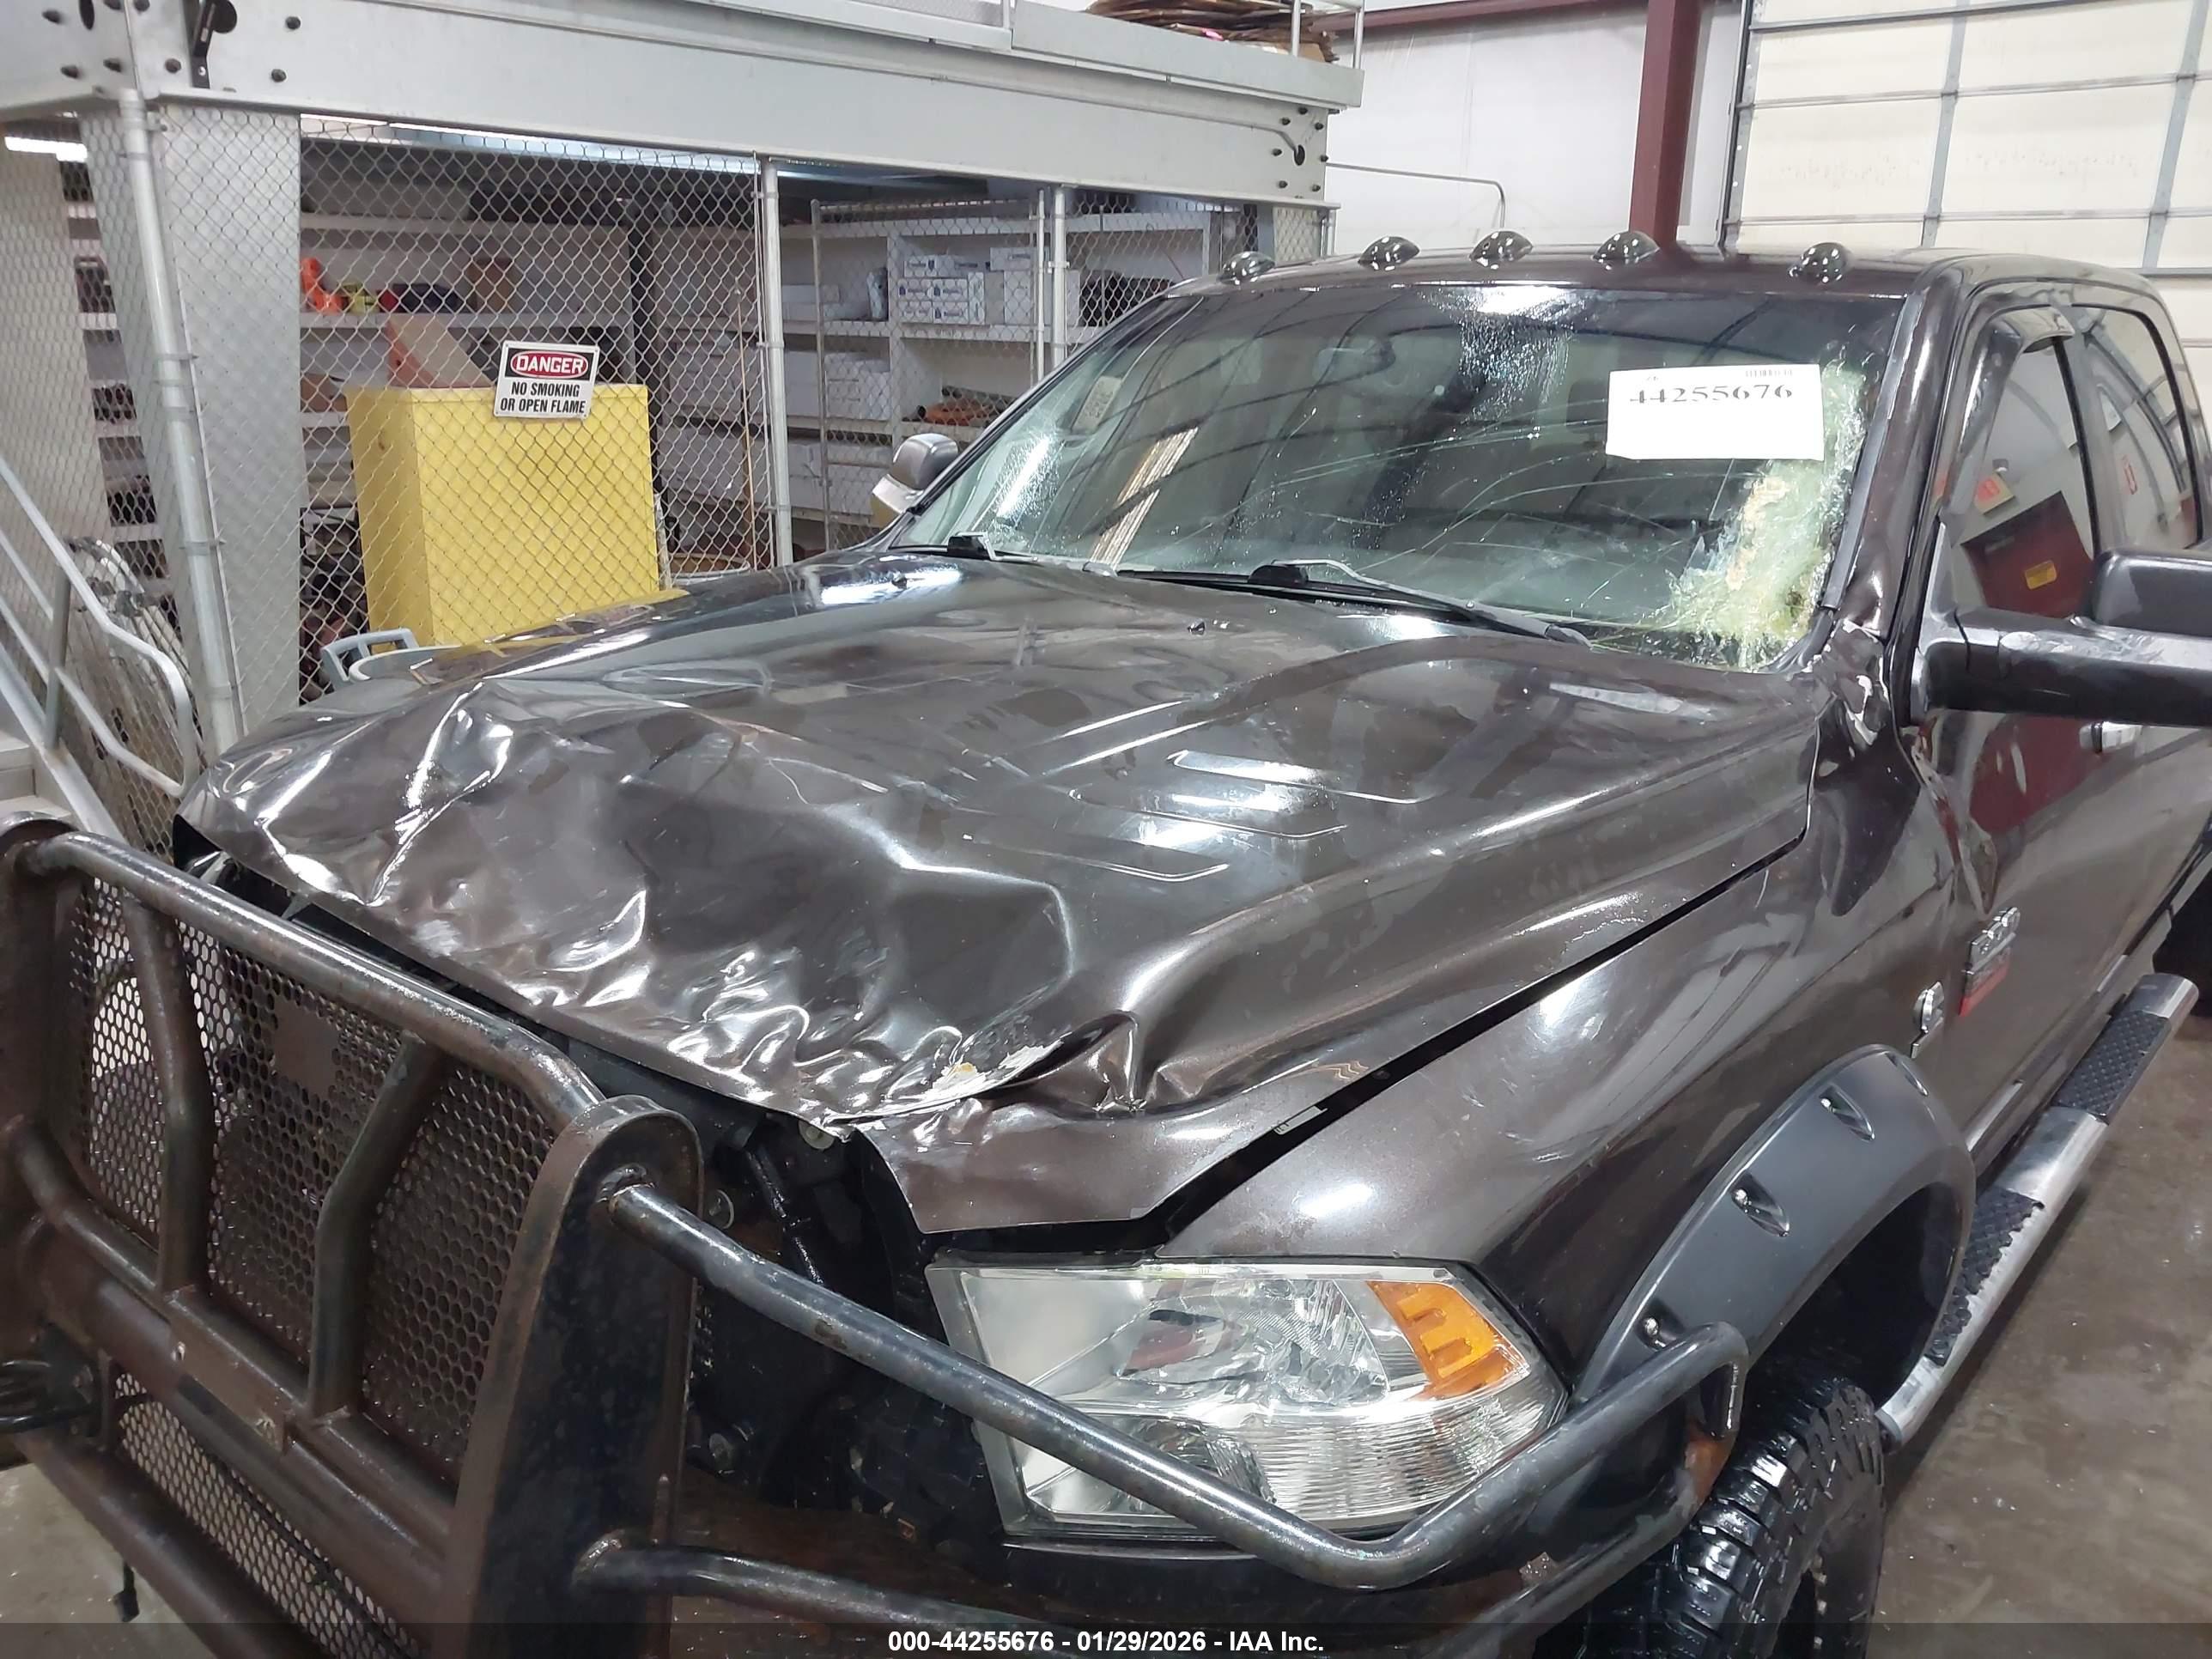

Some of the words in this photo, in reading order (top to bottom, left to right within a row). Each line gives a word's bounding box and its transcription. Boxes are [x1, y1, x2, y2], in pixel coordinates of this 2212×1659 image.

[516, 356, 584, 374] DANGER
[511, 381, 527, 396] NO
[530, 382, 580, 398] SMOKING
[1630, 384, 1793, 404] 44255676
[500, 398, 515, 411] OR
[519, 398, 549, 413] OPEN
[550, 400, 586, 414] FLAME
